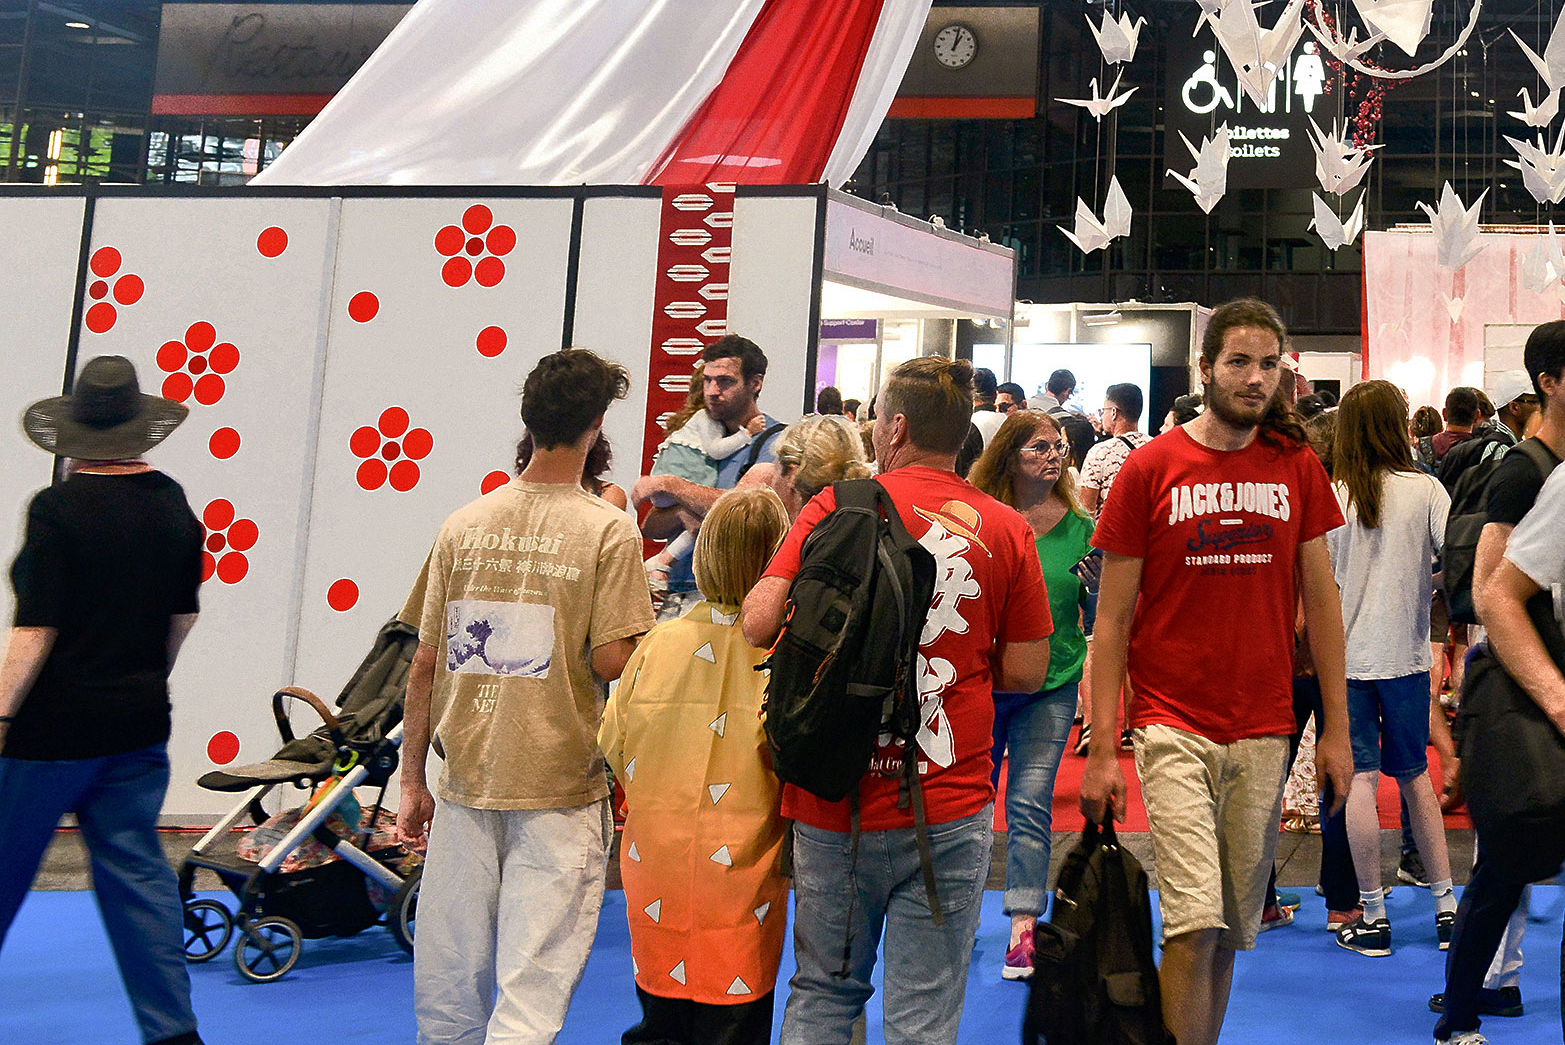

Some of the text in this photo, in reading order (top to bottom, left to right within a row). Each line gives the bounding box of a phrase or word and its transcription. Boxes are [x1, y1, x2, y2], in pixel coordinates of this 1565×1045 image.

[849, 228, 875, 256] Accueil
[1168, 482, 1290, 526] JACK&JONES
[460, 526, 564, 555] Hokusai
[1185, 553, 1273, 566] STANDARD PRODUCT
